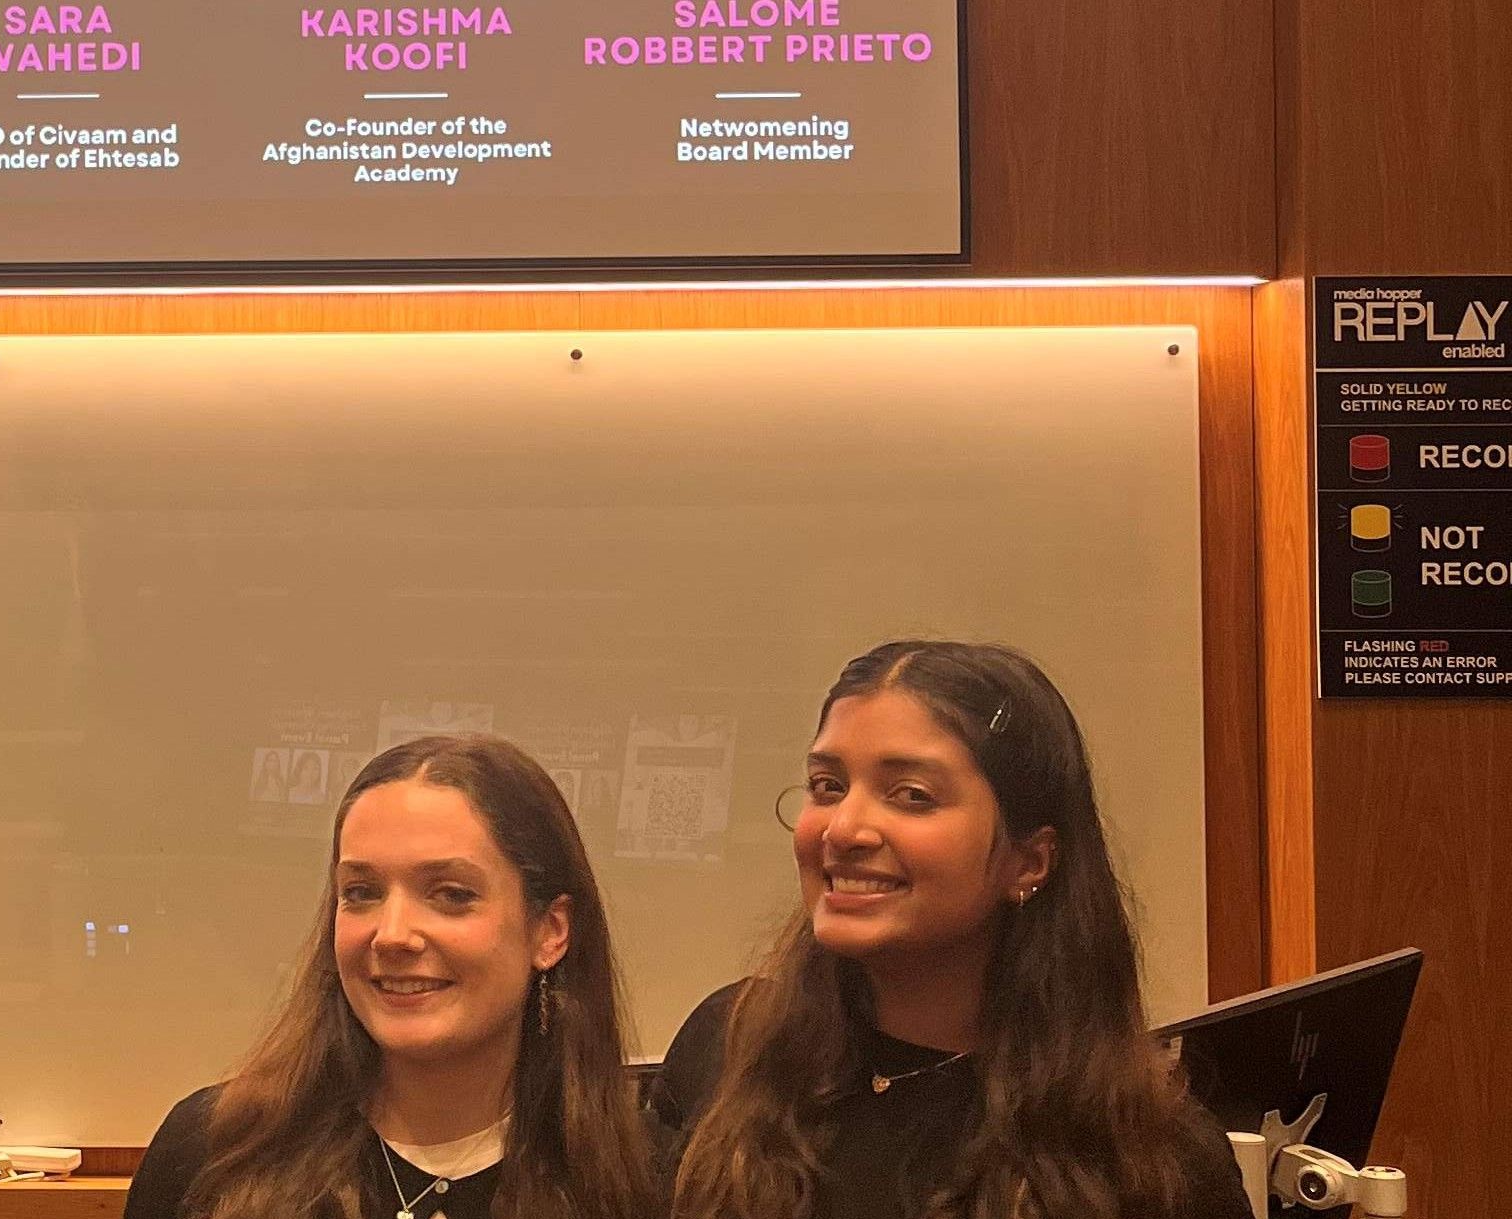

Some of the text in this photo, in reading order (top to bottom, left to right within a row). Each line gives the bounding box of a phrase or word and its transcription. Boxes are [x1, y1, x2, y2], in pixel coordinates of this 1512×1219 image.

[6, 6, 110, 34] SARA
[302, 8, 511, 36] KARISHMA
[676, 0, 838, 28] SALOME
[346, 42, 467, 70] KOOFI
[585, 33, 932, 65] ROBBERT PRIETO
[9, 126, 35, 145] of
[39, 124, 127, 145] Civaam
[131, 123, 177, 144] and
[305, 116, 507, 136] Co-Founder of the
[680, 115, 849, 140] Netwomening
[55, 148, 80, 168] of
[84, 147, 180, 168] Ehtesab
[262, 140, 552, 165] Afghanistan Development
[677, 138, 854, 161] Board Member
[354, 163, 459, 184] Academy
[1334, 287, 1423, 301] media hopper
[1333, 300, 1509, 341] REPLAY
[1442, 343, 1505, 358] enabled
[1340, 383, 1448, 395] SOLID YELLOW
[1341, 400, 1403, 412] GETTING
[1406, 400, 1455, 411] READY
[1459, 399, 1478, 411] TO
[1419, 445, 1512, 468] RECO
[1421, 526, 1485, 549] NOT
[1421, 562, 1512, 585] RECO
[1344, 640, 1449, 652] FLASHING RED
[1344, 656, 1497, 668] INDICATES AN ERROR
[1345, 672, 1401, 684] PLEASE
[1404, 672, 1473, 684] CONTACT
